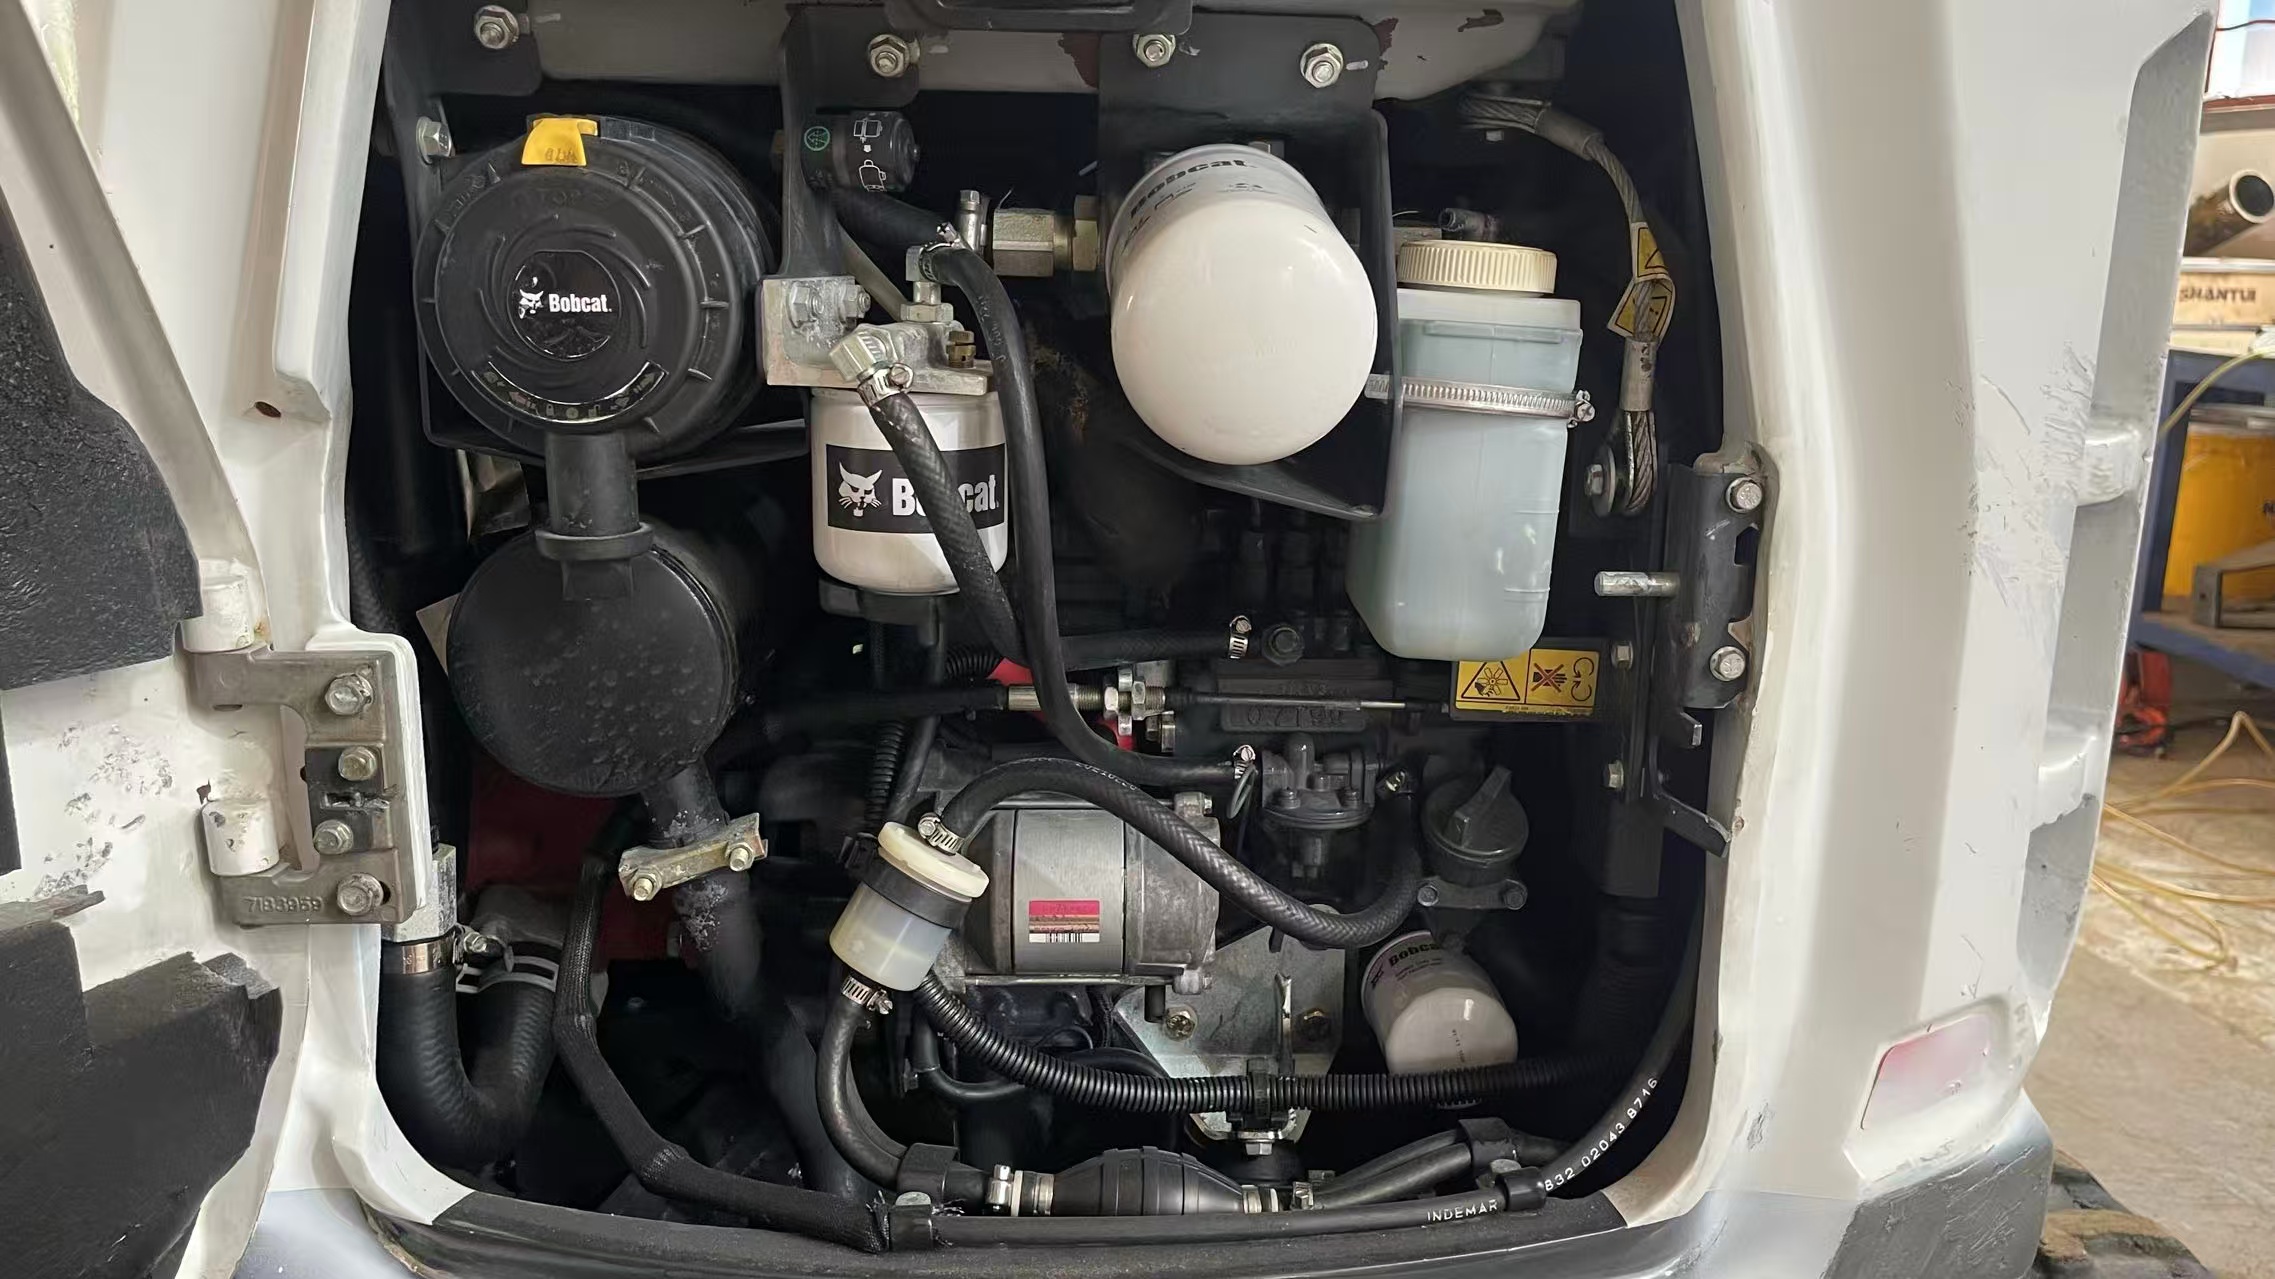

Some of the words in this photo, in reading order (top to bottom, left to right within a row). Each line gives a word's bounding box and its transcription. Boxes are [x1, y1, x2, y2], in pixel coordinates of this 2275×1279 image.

[1427, 1199, 1498, 1222] INDEMAR
[1581, 1122, 1625, 1168] 02043
[1627, 1078, 1658, 1119] 8716
